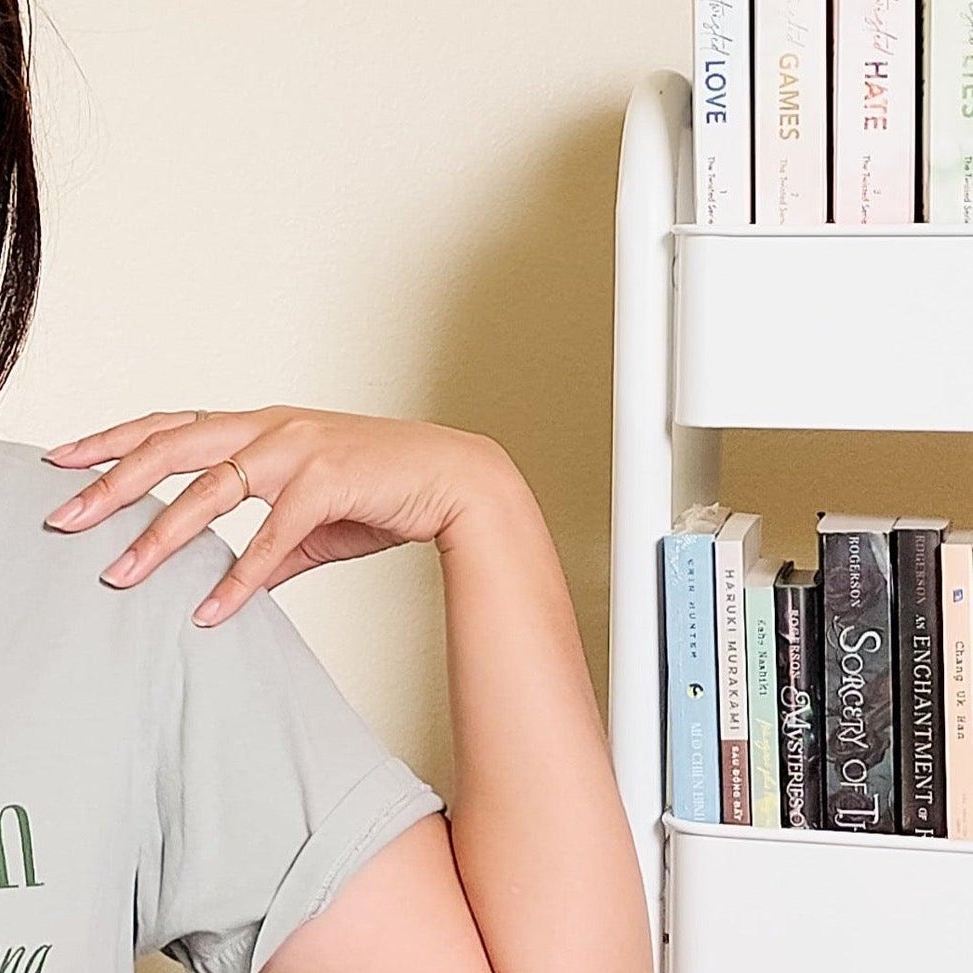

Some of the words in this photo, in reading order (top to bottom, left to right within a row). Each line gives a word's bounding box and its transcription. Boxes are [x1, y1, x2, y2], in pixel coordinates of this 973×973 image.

[705, 60, 727, 124] LOVE
[779, 53, 800, 140] GAMES
[864, 62, 888, 130] HATE
[725, 569, 738, 632] HARUKI
[849, 536, 861, 608] ROGERSON
[789, 609, 801, 679] ROGERSON
[955, 641, 965, 682] Chang
[728, 641, 740, 730] MURAKAMI
[837, 625, 882, 748] SORCERY
[913, 635, 933, 804] ENCHANTMENT
[956, 691, 965, 706] Uk
[781, 686, 811, 808] MYSTERIES
[841, 759, 867, 794] OF
